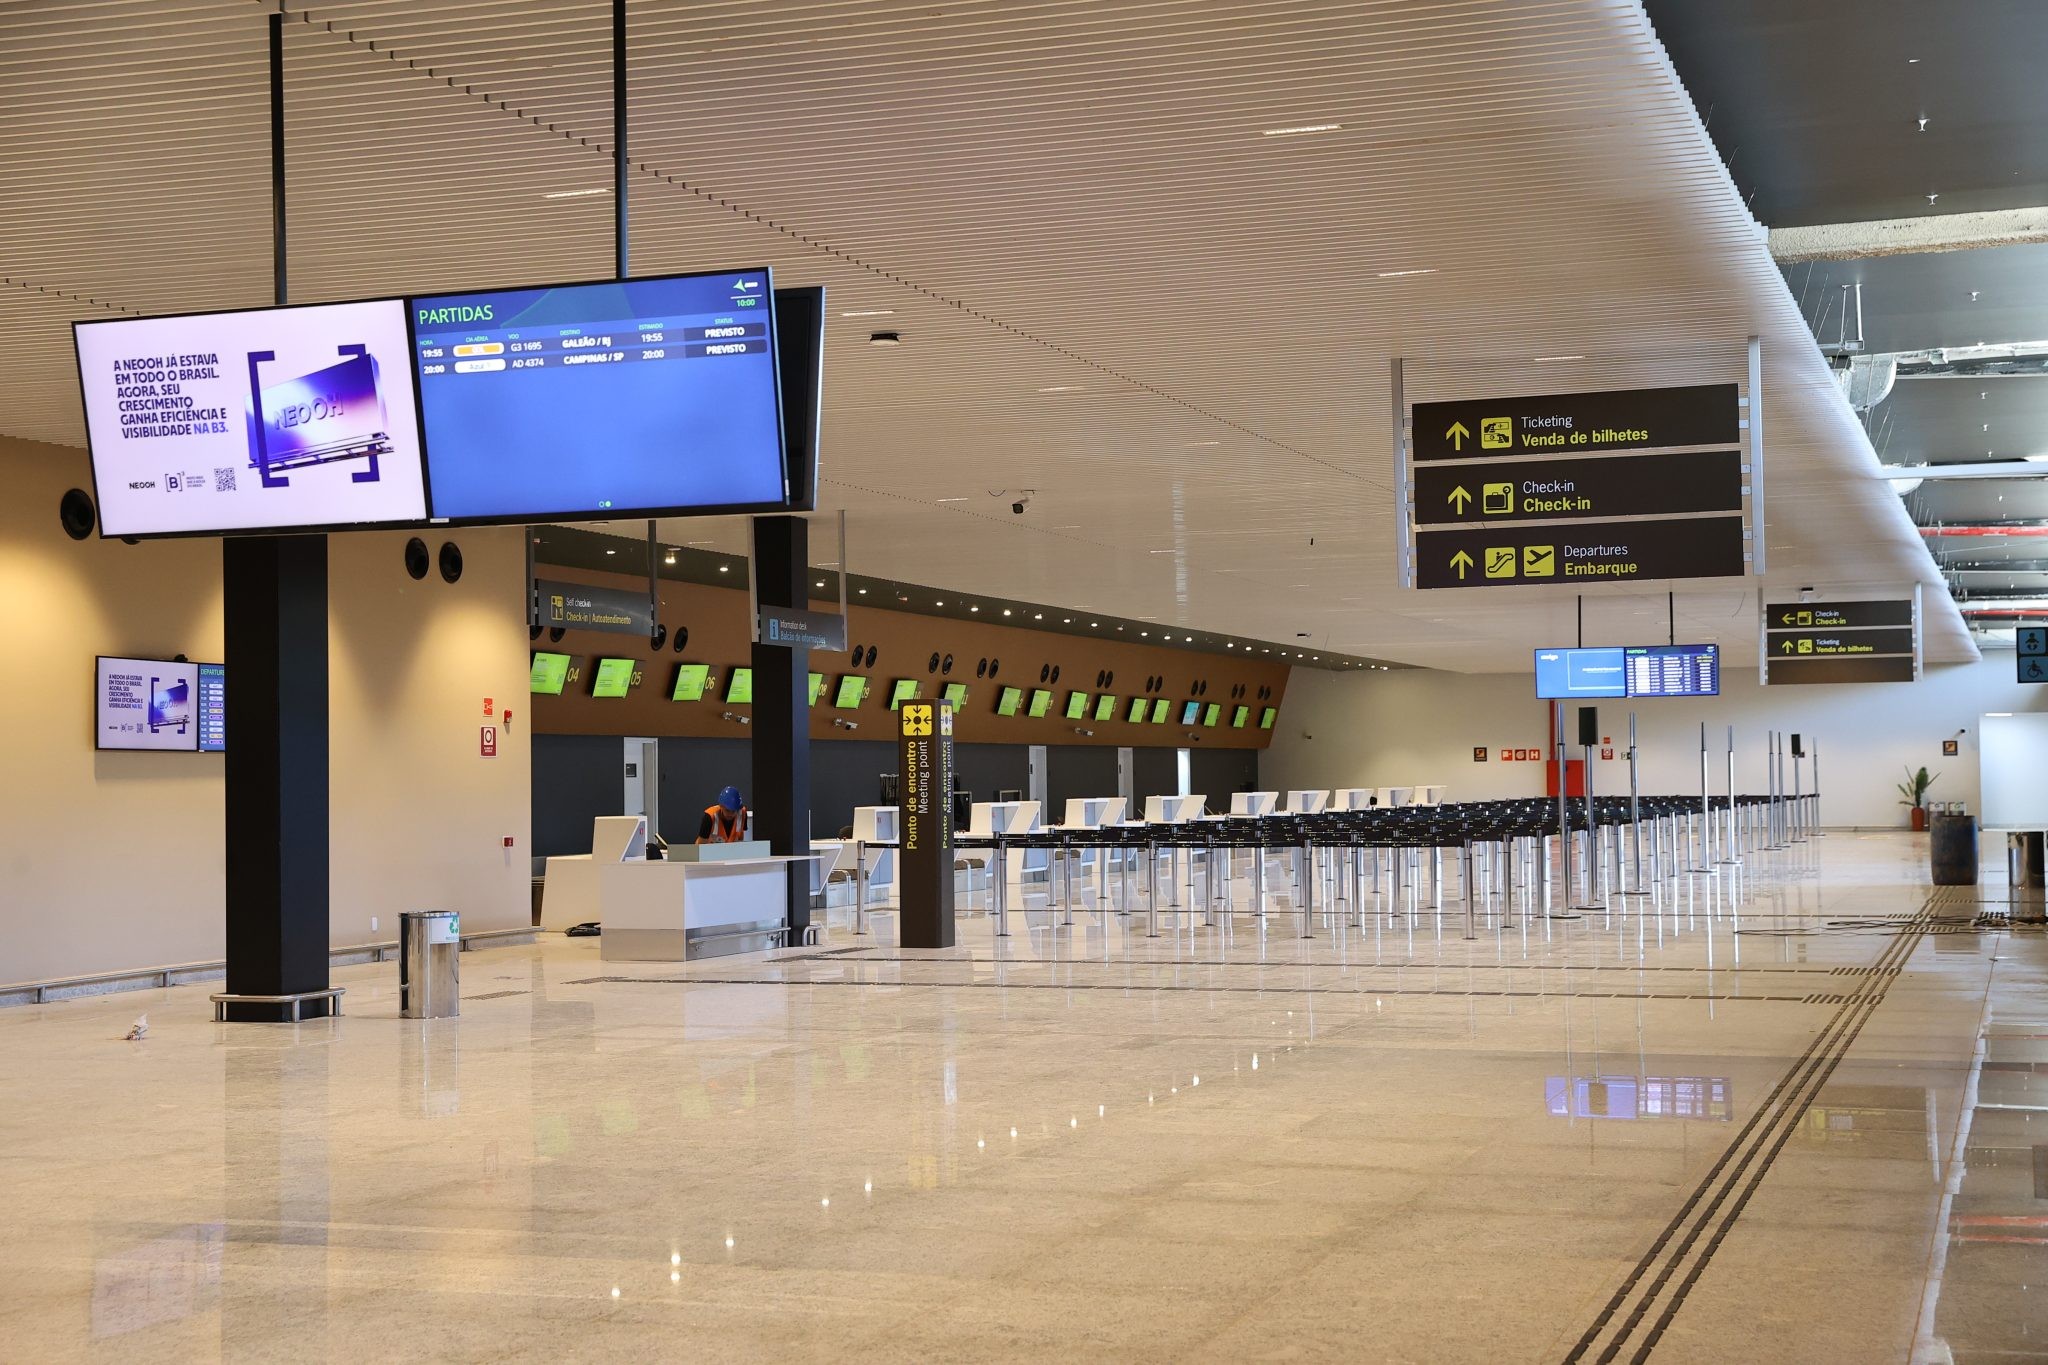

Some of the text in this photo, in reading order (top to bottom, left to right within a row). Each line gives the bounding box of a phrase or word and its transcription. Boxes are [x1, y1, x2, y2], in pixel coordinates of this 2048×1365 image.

[419, 304, 494, 324] PARTIDAS
[422, 348, 444, 358] 19:55
[510, 342, 522, 352] G3
[522, 342, 542, 351] 1695
[562, 336, 596, 348] GALEÃO
[602, 336, 612, 348] RJ
[641, 333, 664, 342] 19:55
[704, 326, 745, 338] PREVISTO
[114, 353, 218, 372] A NEOOH JÁ ESTAVA
[424, 364, 445, 374] 20:00
[512, 360, 524, 368] AD
[524, 358, 544, 368] 4374
[564, 353, 608, 364] CAMPINAS
[613, 352, 624, 362] SP
[642, 350, 664, 360] 20:00
[706, 344, 746, 354] PREVISTO
[115, 367, 220, 385] EM TODO O BRASIL.
[118, 383, 180, 398] AGORA, SEU
[118, 396, 194, 412] CRESCIMENTO
[273, 391, 344, 432] NEOOH
[120, 407, 226, 426] GANHA EFICIÊNCIA E
[1521, 414, 1572, 430] Ticketing
[122, 421, 229, 439] VISIBILIDADE NA B3.
[1522, 428, 1648, 447] Venda de bilhetes
[129, 481, 156, 490] NEOOH
[1523, 480, 1574, 494] Check-in
[1523, 496, 1591, 512] Check-in
[1564, 544, 1628, 559] Departures
[1564, 561, 1638, 578] Embarque
[566, 597, 574, 606] Self
[566, 611, 588, 622] Check-in
[592, 613, 632, 625] Autoatendimento
[567, 668, 580, 682] 04
[630, 672, 642, 686] 05
[704, 676, 716, 690] 06
[918, 740, 930, 814] Meeting point
[906, 741, 918, 850] Ponto de encontro
[942, 798, 948, 812] de
